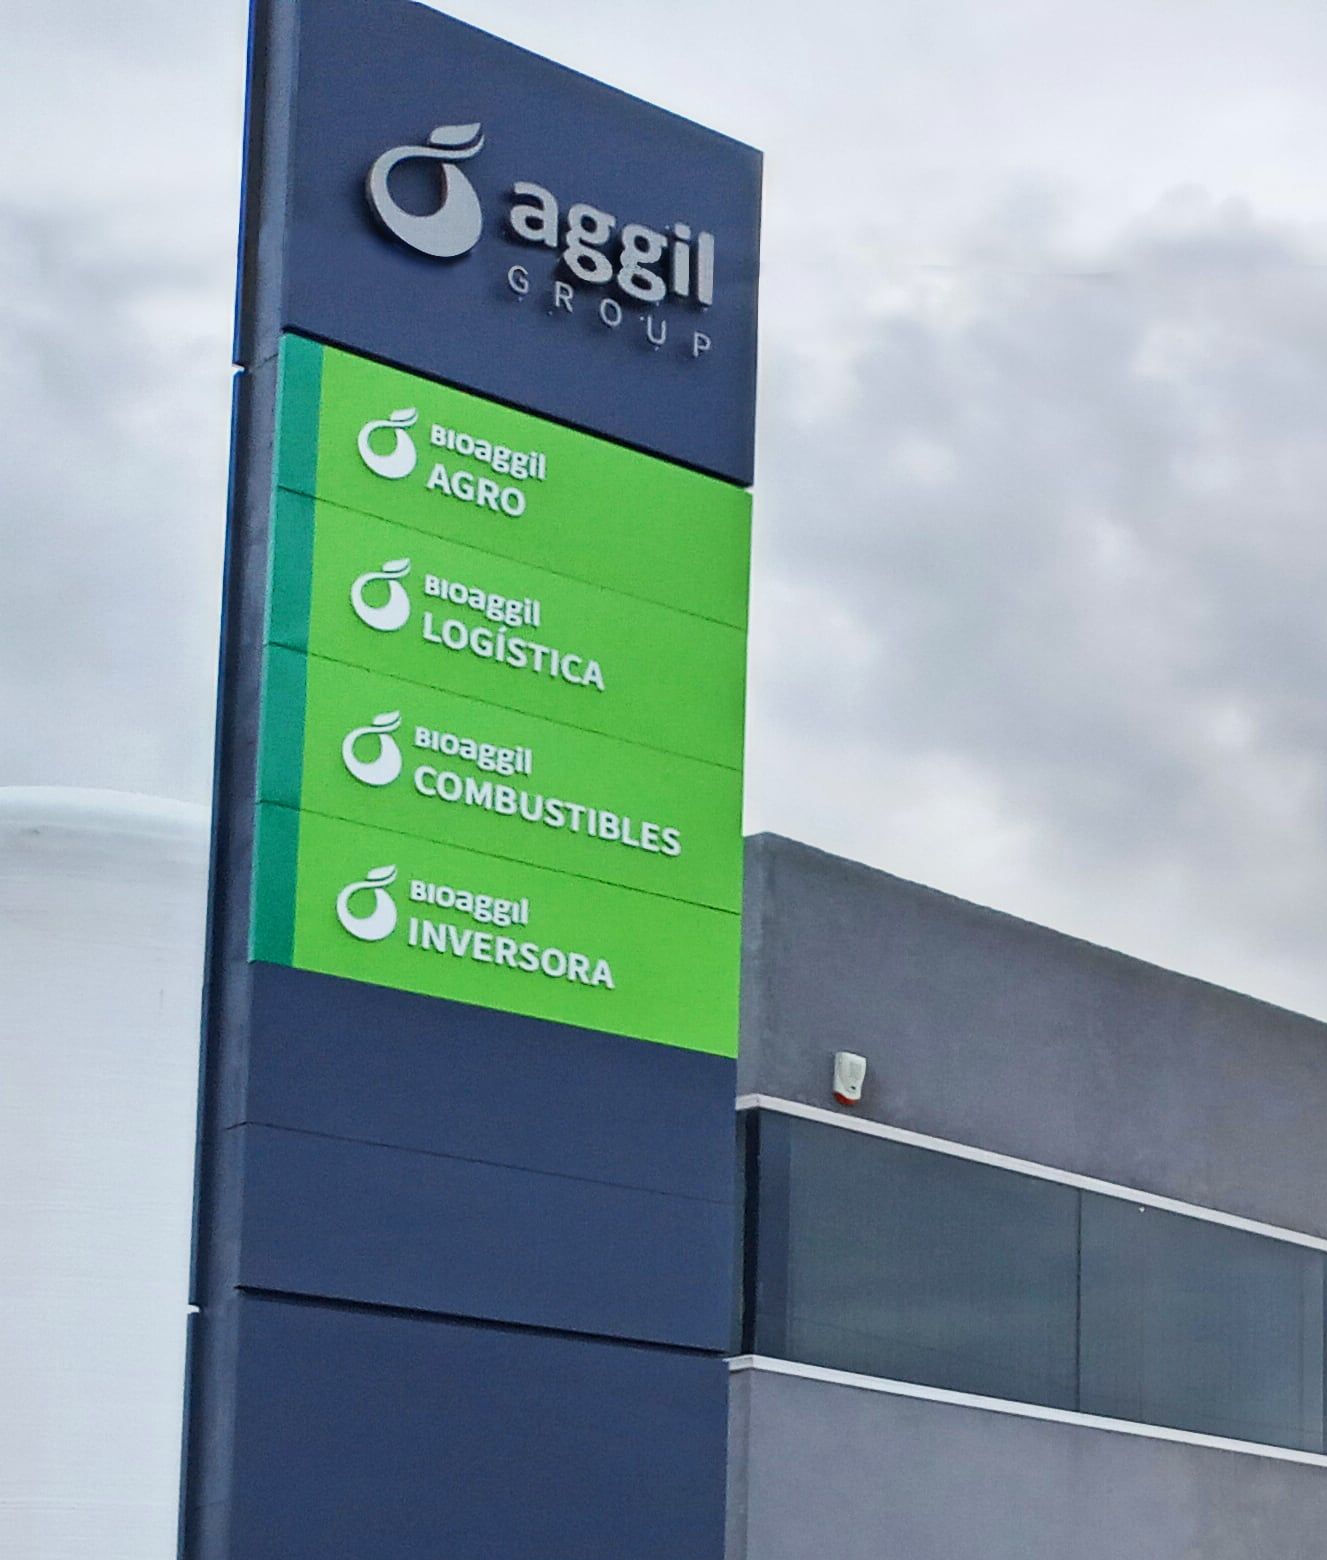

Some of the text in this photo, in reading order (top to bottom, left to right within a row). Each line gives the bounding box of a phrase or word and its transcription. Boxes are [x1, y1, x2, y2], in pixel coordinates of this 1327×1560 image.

[508, 181, 716, 306] aggil
[507, 264, 712, 358] GROUP
[430, 423, 548, 481] BIOaggil
[426, 463, 527, 518] AGRO
[424, 574, 541, 627] BIOaggil
[422, 613, 606, 690] LOGÍSTICA
[413, 726, 533, 775] BIOaggil
[413, 765, 682, 857] COMBUSTIBLES
[409, 879, 529, 926] BIOaggil
[408, 917, 616, 989] INVERSORA
